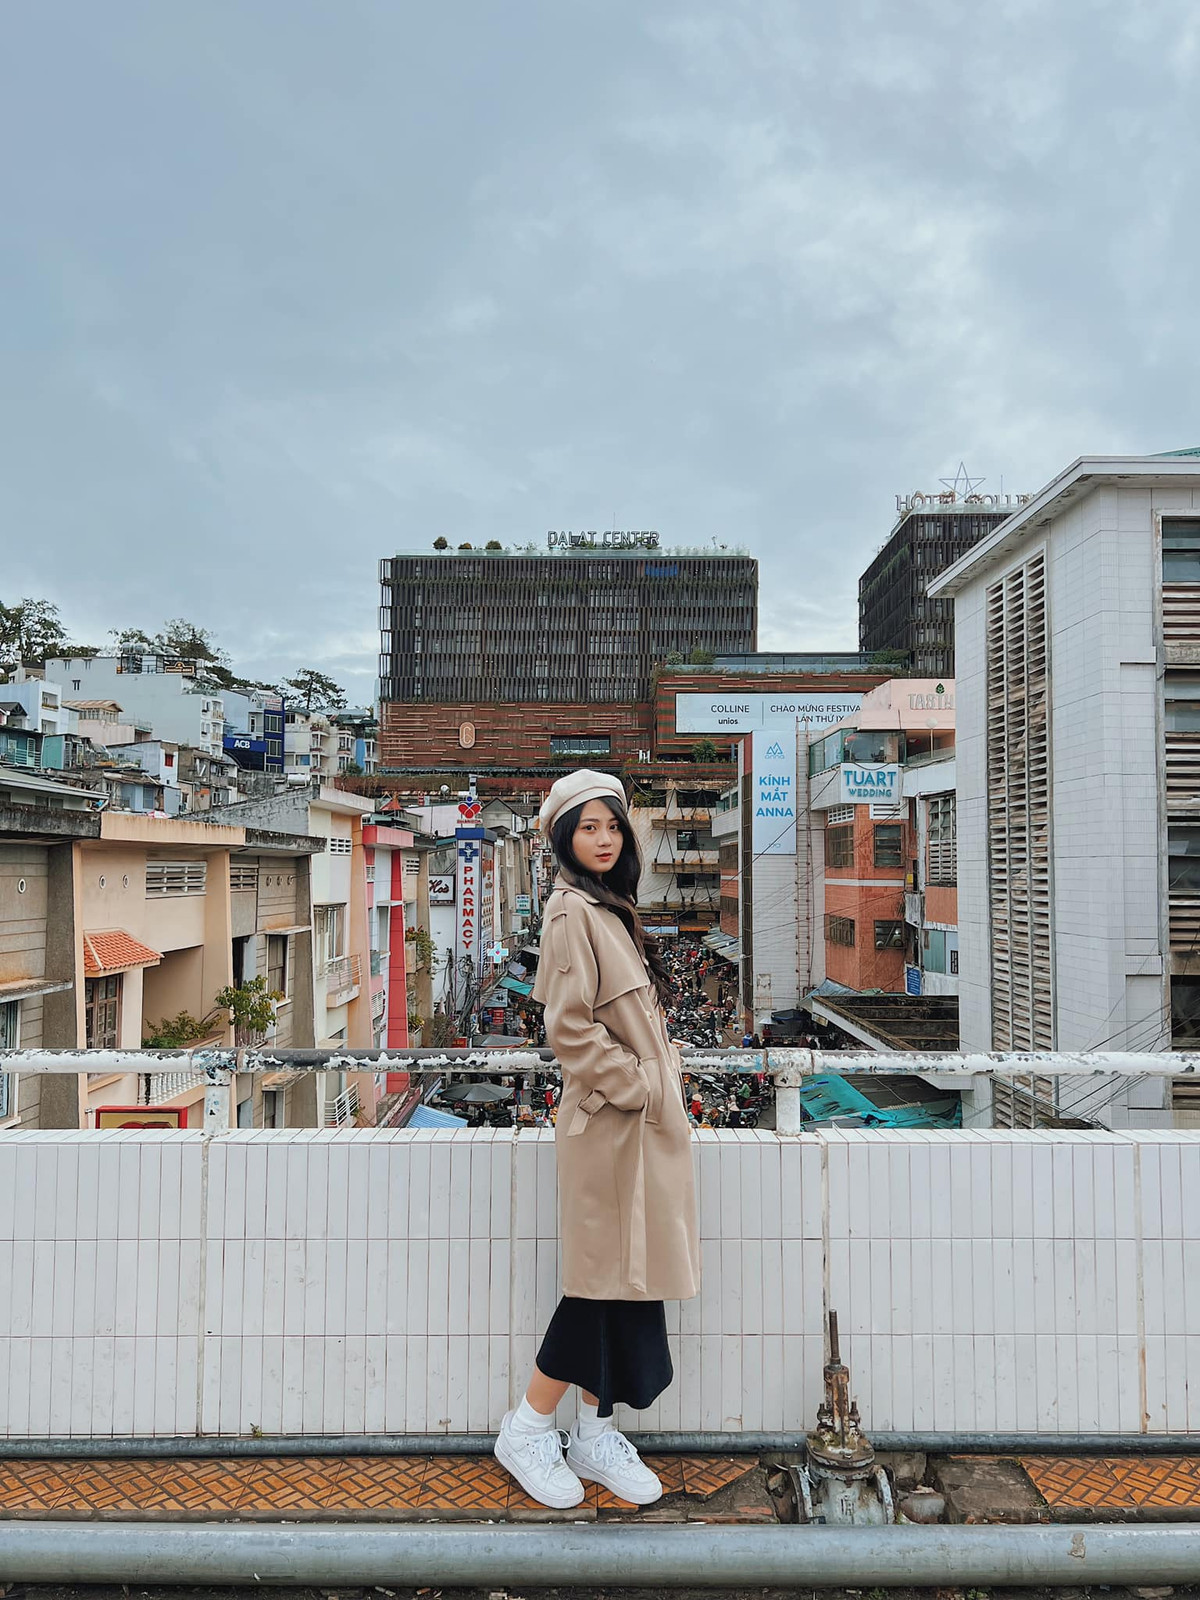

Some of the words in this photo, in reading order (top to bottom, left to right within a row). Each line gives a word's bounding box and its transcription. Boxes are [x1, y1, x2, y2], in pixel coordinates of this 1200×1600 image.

[547, 531, 597, 546] DALAT
[603, 531, 660, 546] CENTER
[711, 704, 750, 713] COLLINE
[718, 717, 739, 725] unios
[234, 740, 250, 749] ACB
[759, 773, 791, 786] KÍNH
[843, 770, 896, 787] TUART
[761, 787, 788, 802] MẮT
[848, 788, 892, 798] WEDDING
[755, 807, 794, 817] ANNA
[462, 866, 475, 950] PHARMACY
